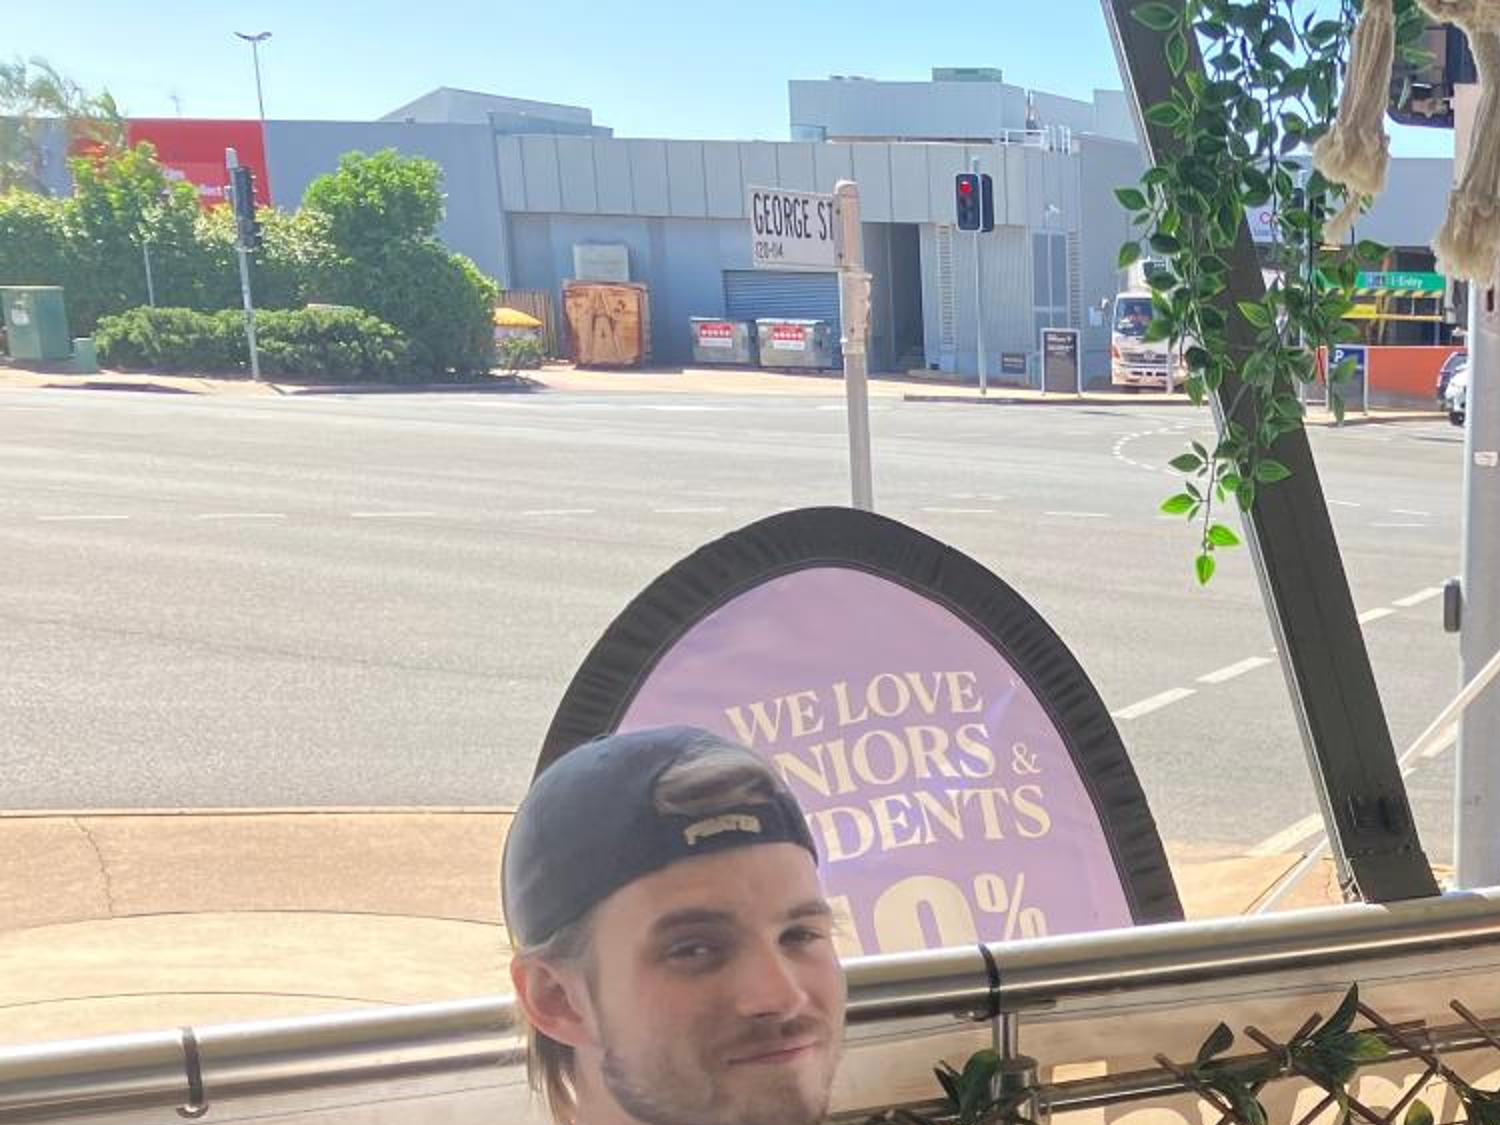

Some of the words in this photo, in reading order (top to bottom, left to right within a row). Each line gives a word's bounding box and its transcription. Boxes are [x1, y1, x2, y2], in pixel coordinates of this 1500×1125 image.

[753, 192, 812, 239] GEORGE
[817, 201, 834, 241] ST
[725, 691, 825, 745] WE
[832, 671, 984, 727] LOVE
[770, 722, 997, 797] NIORS
[1011, 742, 1041, 776] &
[805, 785, 1052, 862] DENTS
